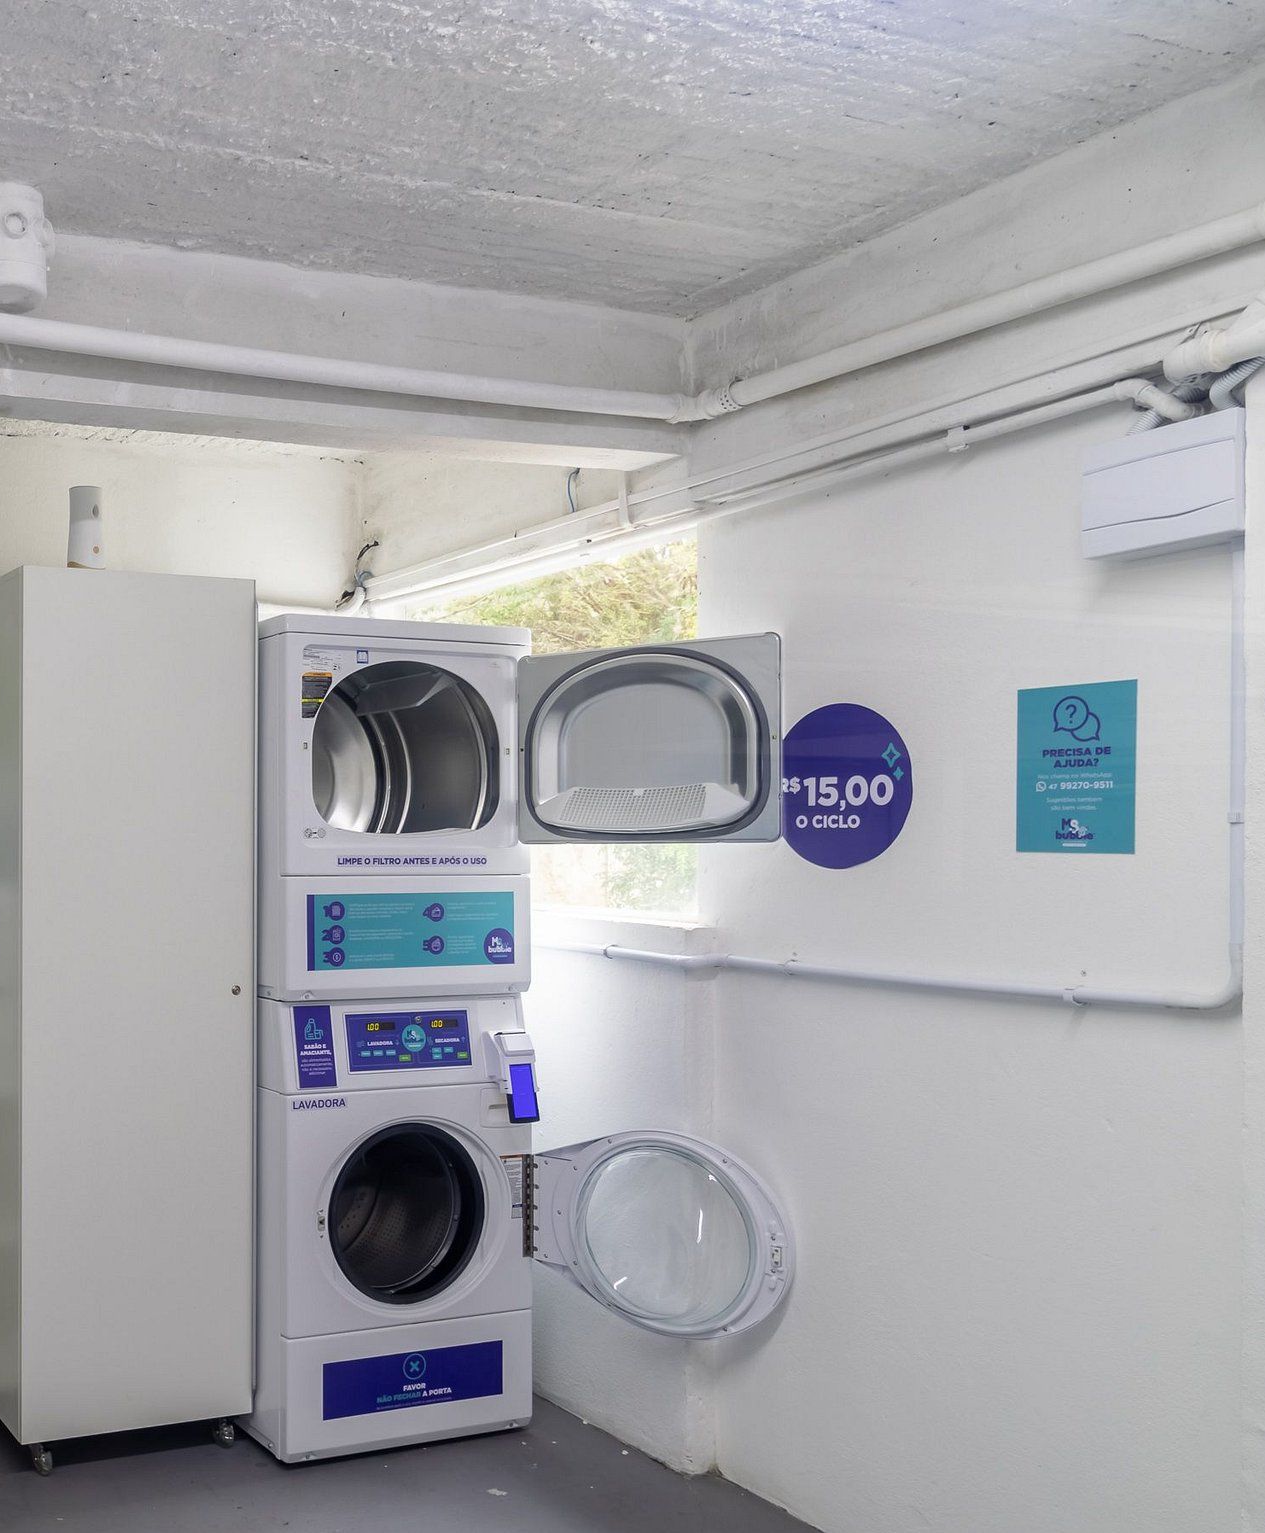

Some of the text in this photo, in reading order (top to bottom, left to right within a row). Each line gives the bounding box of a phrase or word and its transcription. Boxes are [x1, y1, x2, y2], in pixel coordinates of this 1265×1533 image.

[1042, 746, 1112, 758] PRECISA DE
[1053, 758, 1099, 768] AJUDA?
[1060, 780, 1113, 790] 99270-9511
[803, 774, 894, 811] 15,00
[795, 814, 861, 829] O CICLO
[1055, 831, 1094, 840] bubble
[338, 856, 487, 865] LIMPE O FILTRO ANTES E APÓS O USO
[292, 1098, 346, 1110] LAVADORA
[403, 1382, 426, 1392] FAVOR
[376, 1394, 392, 1403] NÃO
[393, 1391, 421, 1401] FECHAR
[428, 1387, 452, 1396] PORTA
